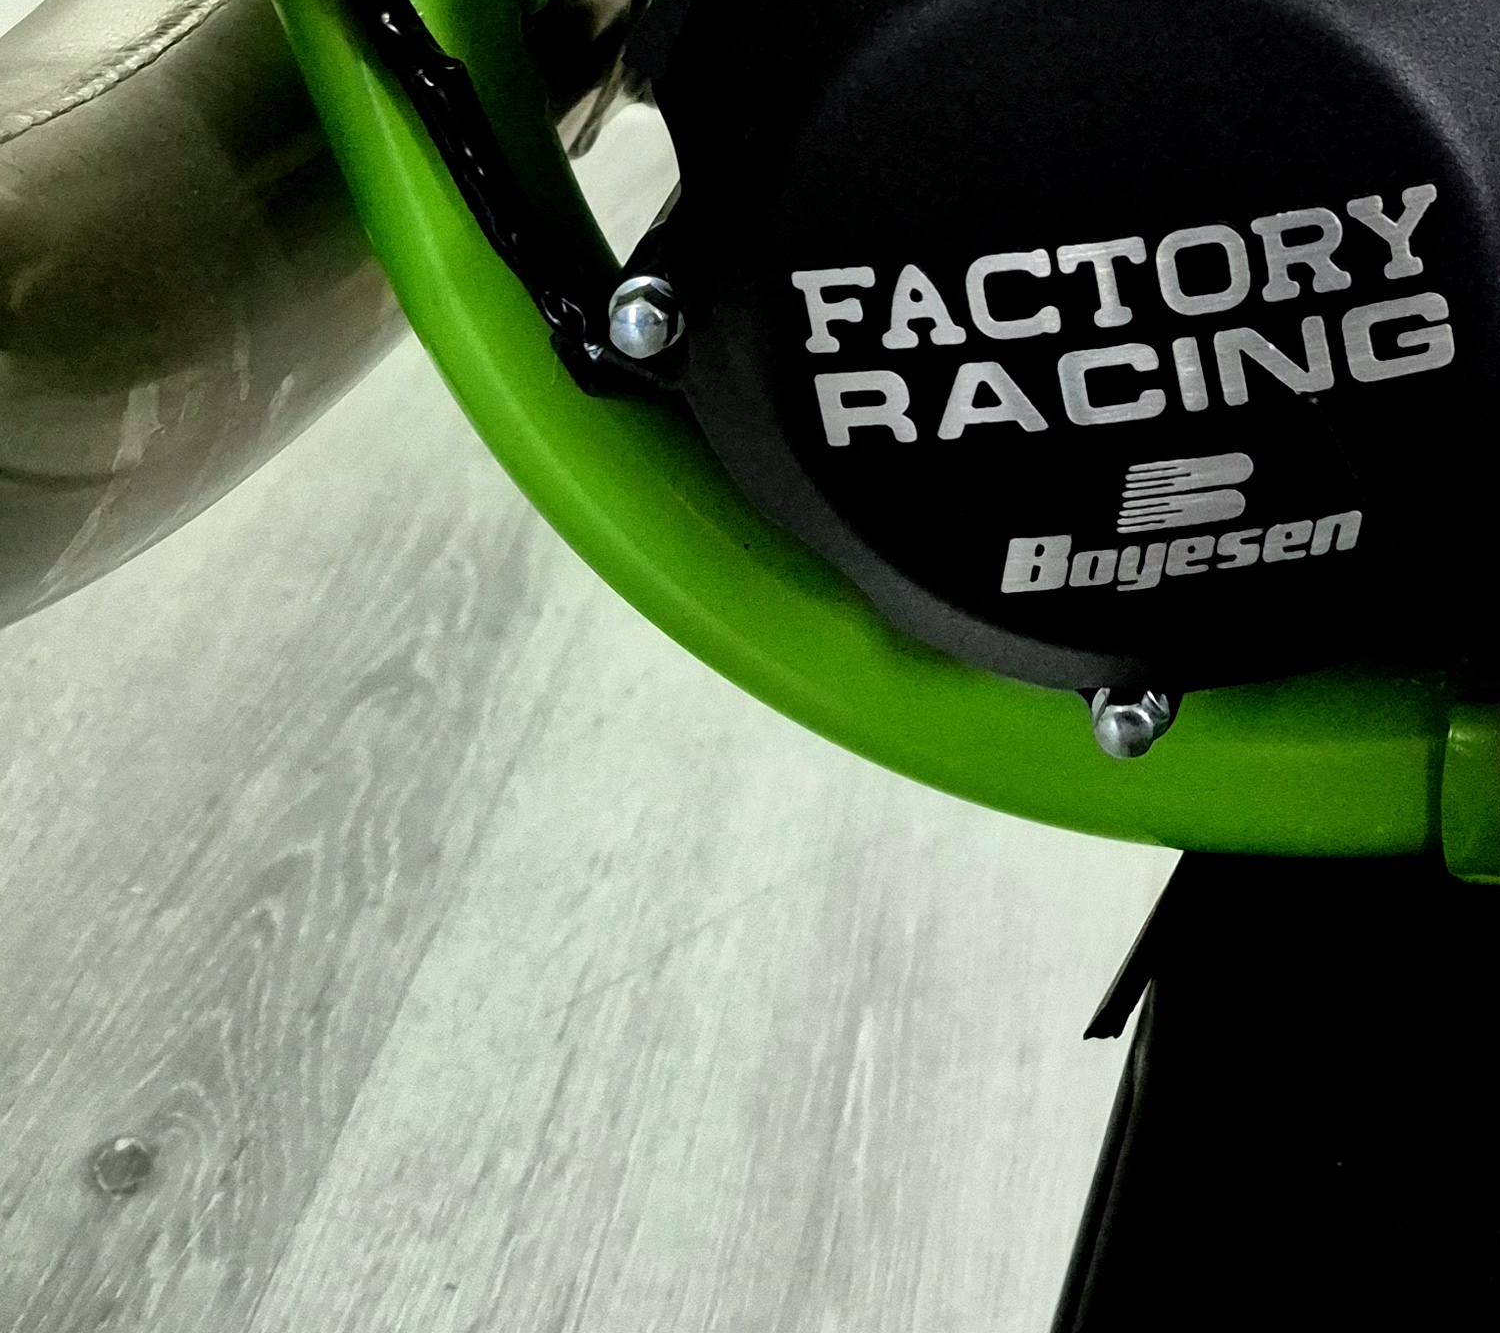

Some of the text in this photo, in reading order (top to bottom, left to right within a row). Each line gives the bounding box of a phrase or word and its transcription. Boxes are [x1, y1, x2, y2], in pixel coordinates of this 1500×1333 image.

[790, 183, 1438, 354] FACTORY
[813, 291, 1456, 447] RACING
[1000, 509, 1363, 594] Boyesen
